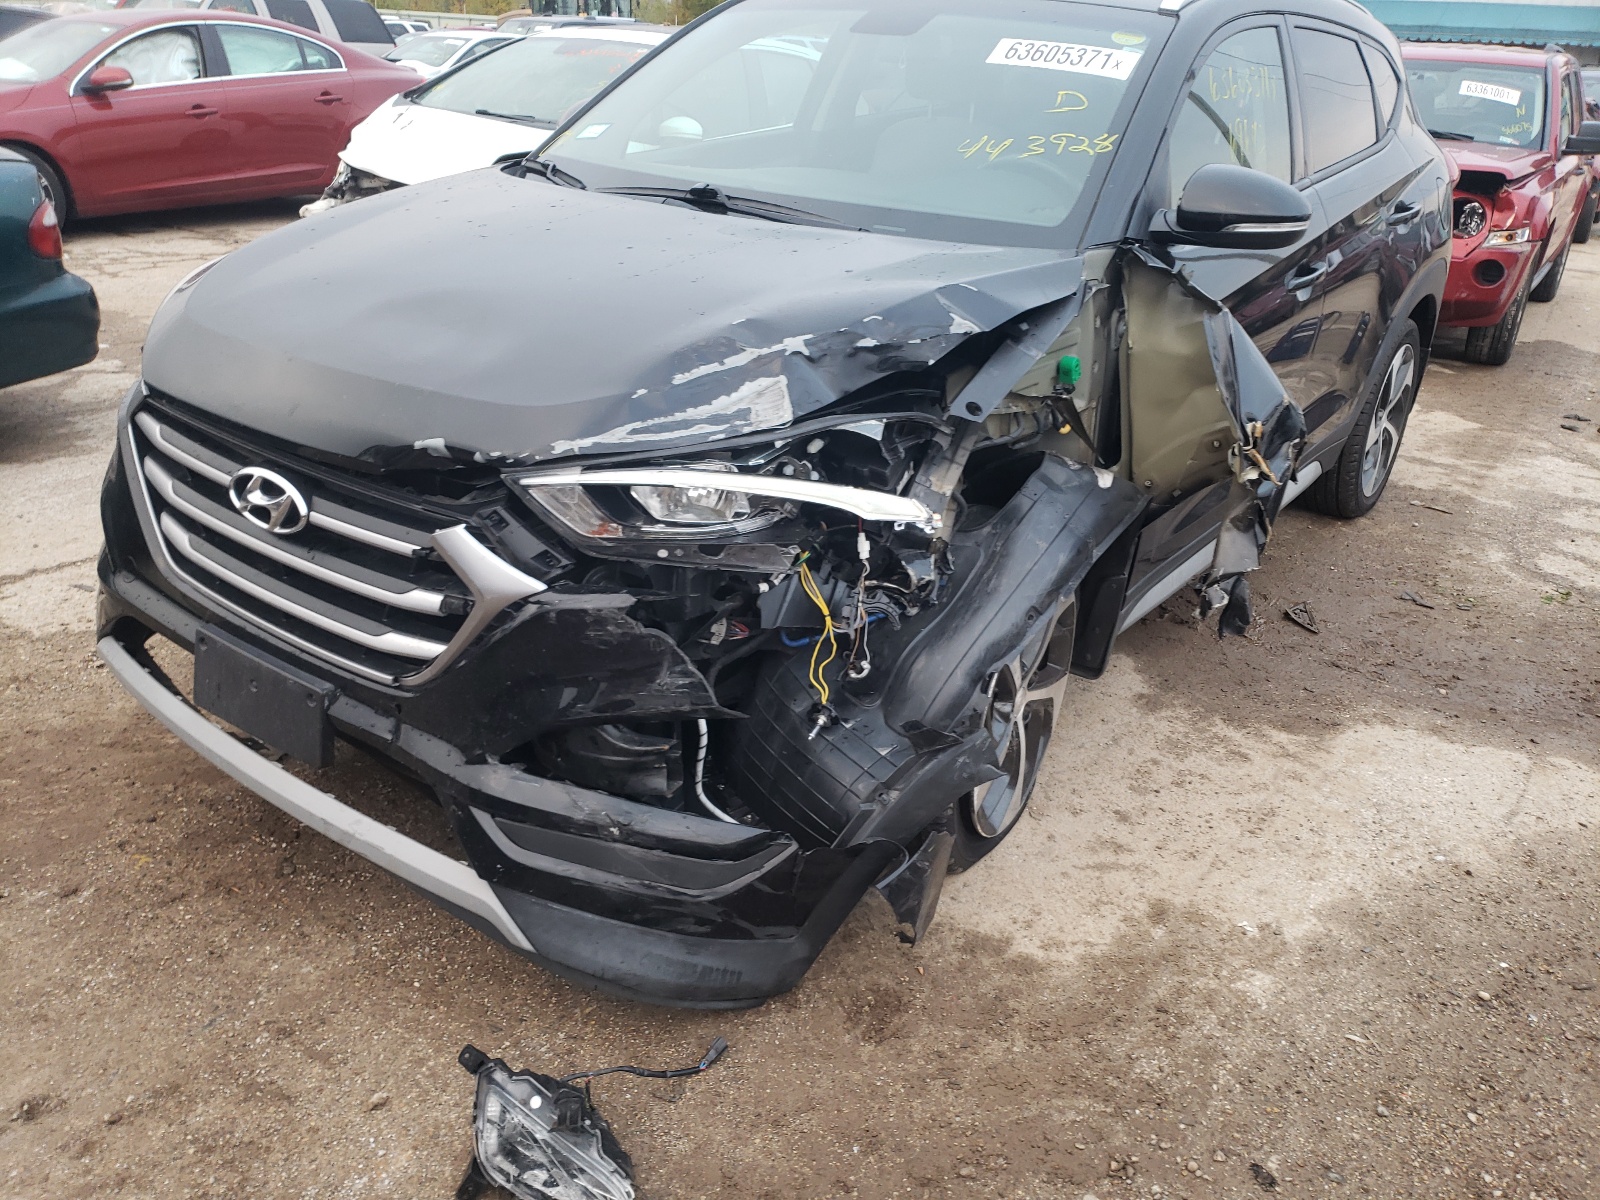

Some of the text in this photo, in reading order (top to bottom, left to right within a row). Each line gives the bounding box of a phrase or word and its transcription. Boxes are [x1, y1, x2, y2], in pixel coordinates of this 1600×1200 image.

[1004, 42, 1113, 70] 63605371
[1044, 90, 1089, 112] D
[1466, 83, 1510, 99] 63361001
